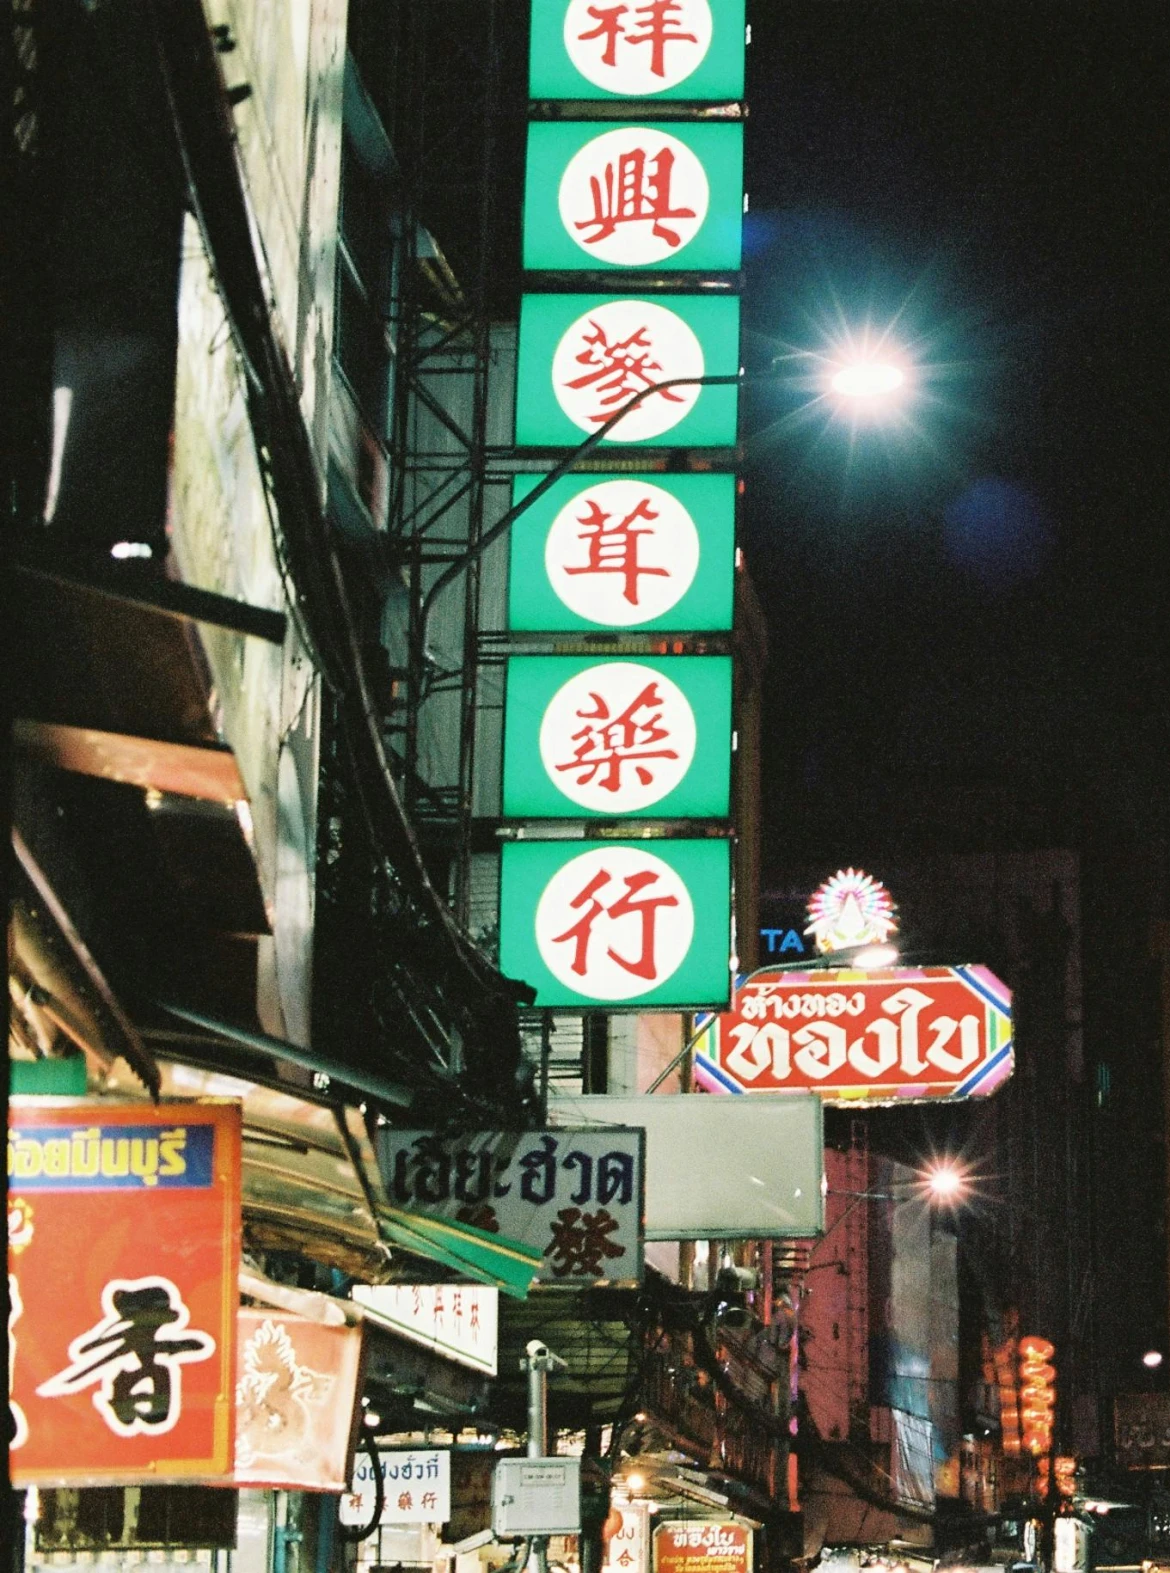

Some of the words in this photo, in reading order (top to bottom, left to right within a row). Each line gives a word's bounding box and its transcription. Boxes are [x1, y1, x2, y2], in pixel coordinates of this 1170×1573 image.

[741, 985, 865, 1019] ห้างทอง
[726, 988, 980, 1080] ทองใบ
